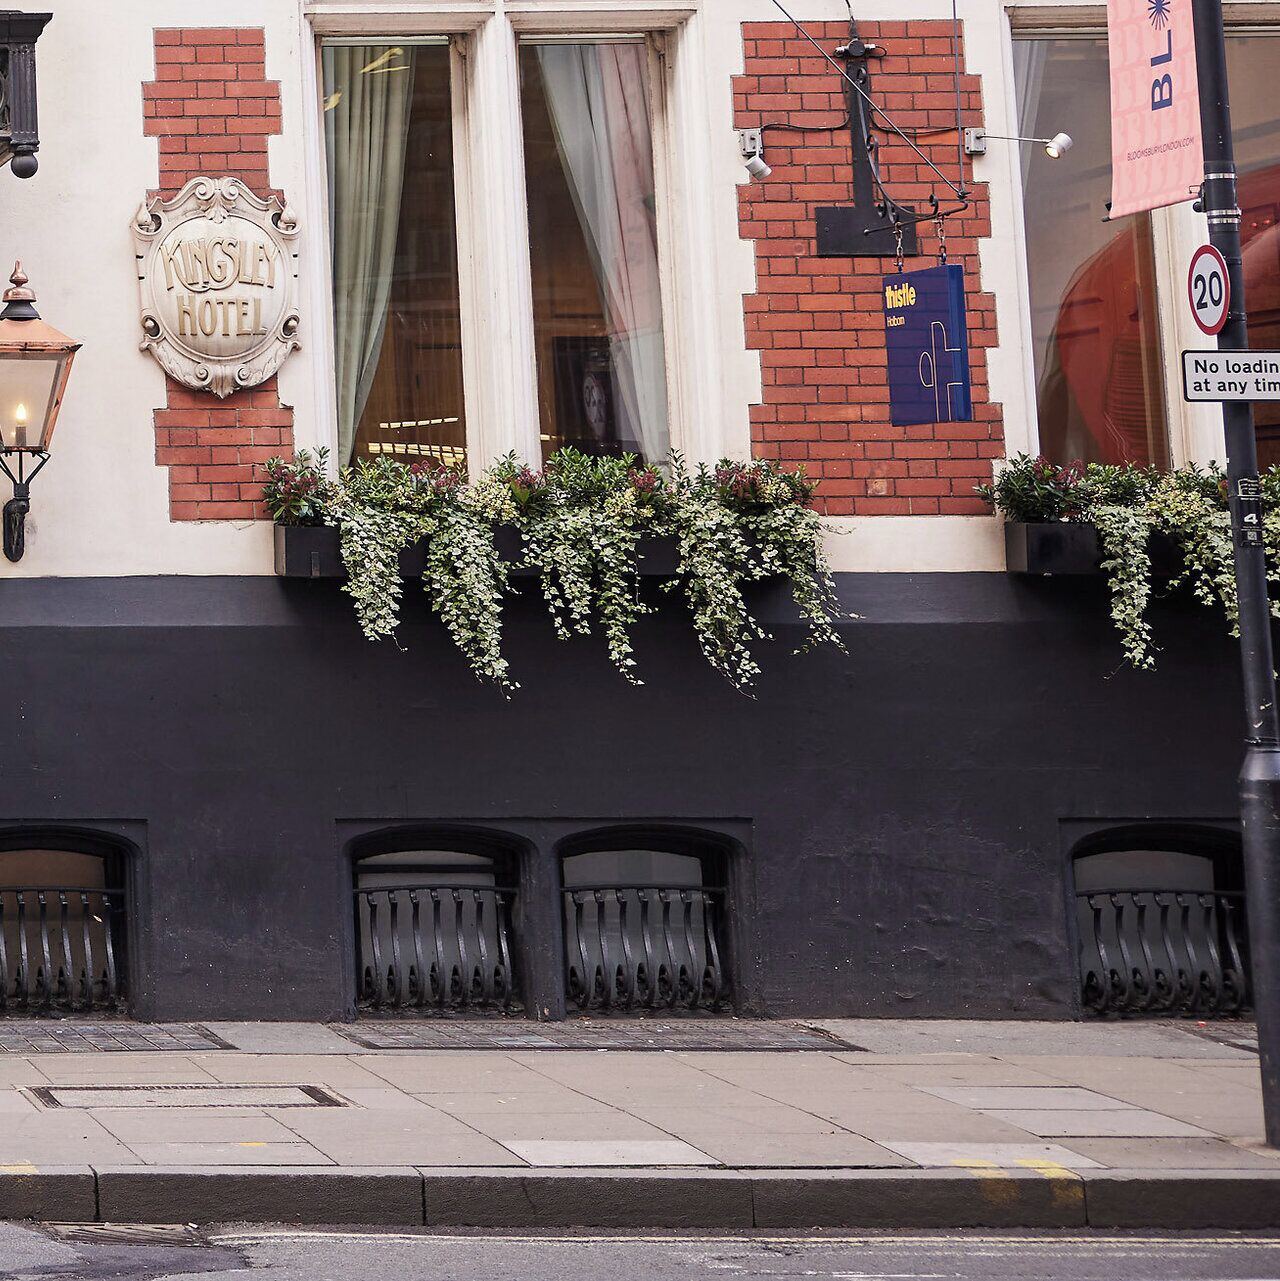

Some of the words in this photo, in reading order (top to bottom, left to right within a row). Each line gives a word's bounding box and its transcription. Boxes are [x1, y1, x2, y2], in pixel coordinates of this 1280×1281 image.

[159, 237, 280, 293] KINGSLEY
[885, 282, 916, 309] thistle
[1194, 271, 1223, 310] 20
[176, 293, 268, 336] HOTEL
[1194, 360, 1219, 374] No
[1225, 360, 1280, 374] loadin
[1193, 378, 1211, 392] at
[1217, 381, 1247, 394] any
[1254, 379, 1280, 392] tim
